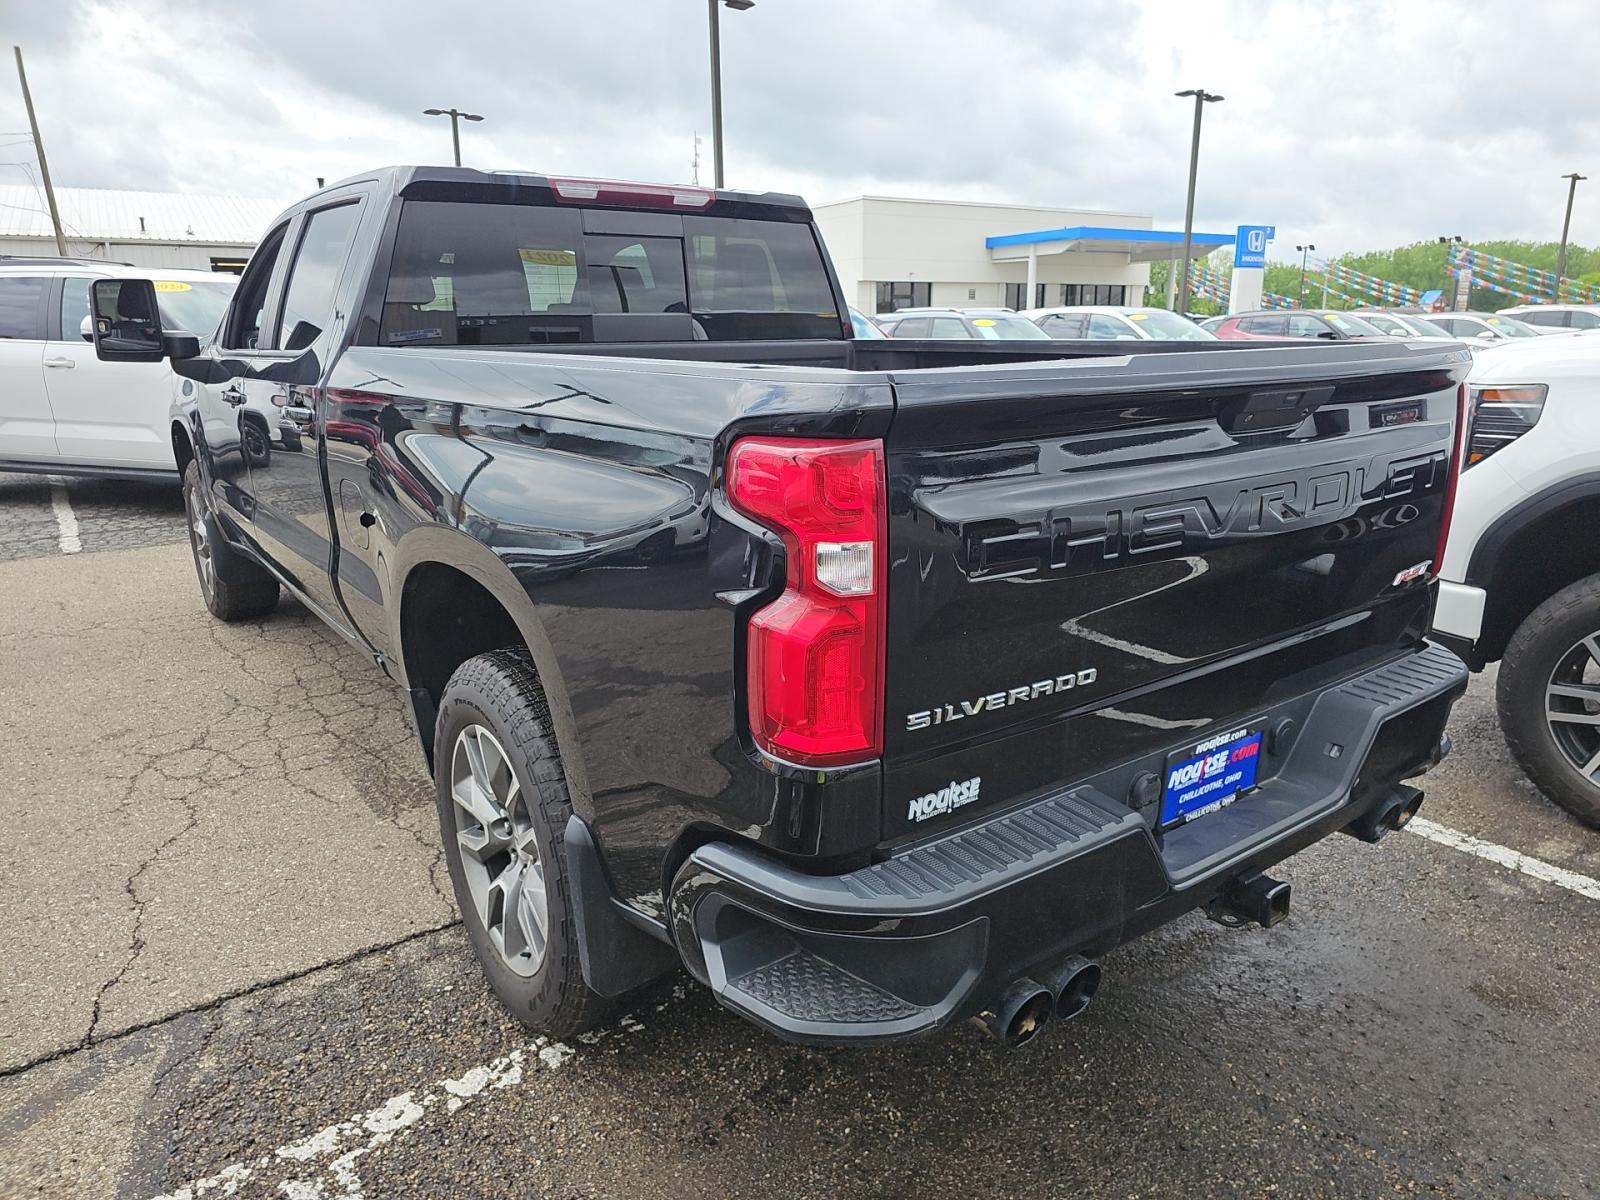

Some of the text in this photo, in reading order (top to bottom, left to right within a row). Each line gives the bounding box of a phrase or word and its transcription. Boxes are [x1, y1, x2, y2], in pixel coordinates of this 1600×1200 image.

[962, 449, 1447, 582] CHEVROLET
[906, 667, 1098, 732] SILVERADO
[907, 776, 981, 820] NOURSE
[1224, 771, 1243, 785] OHIO
